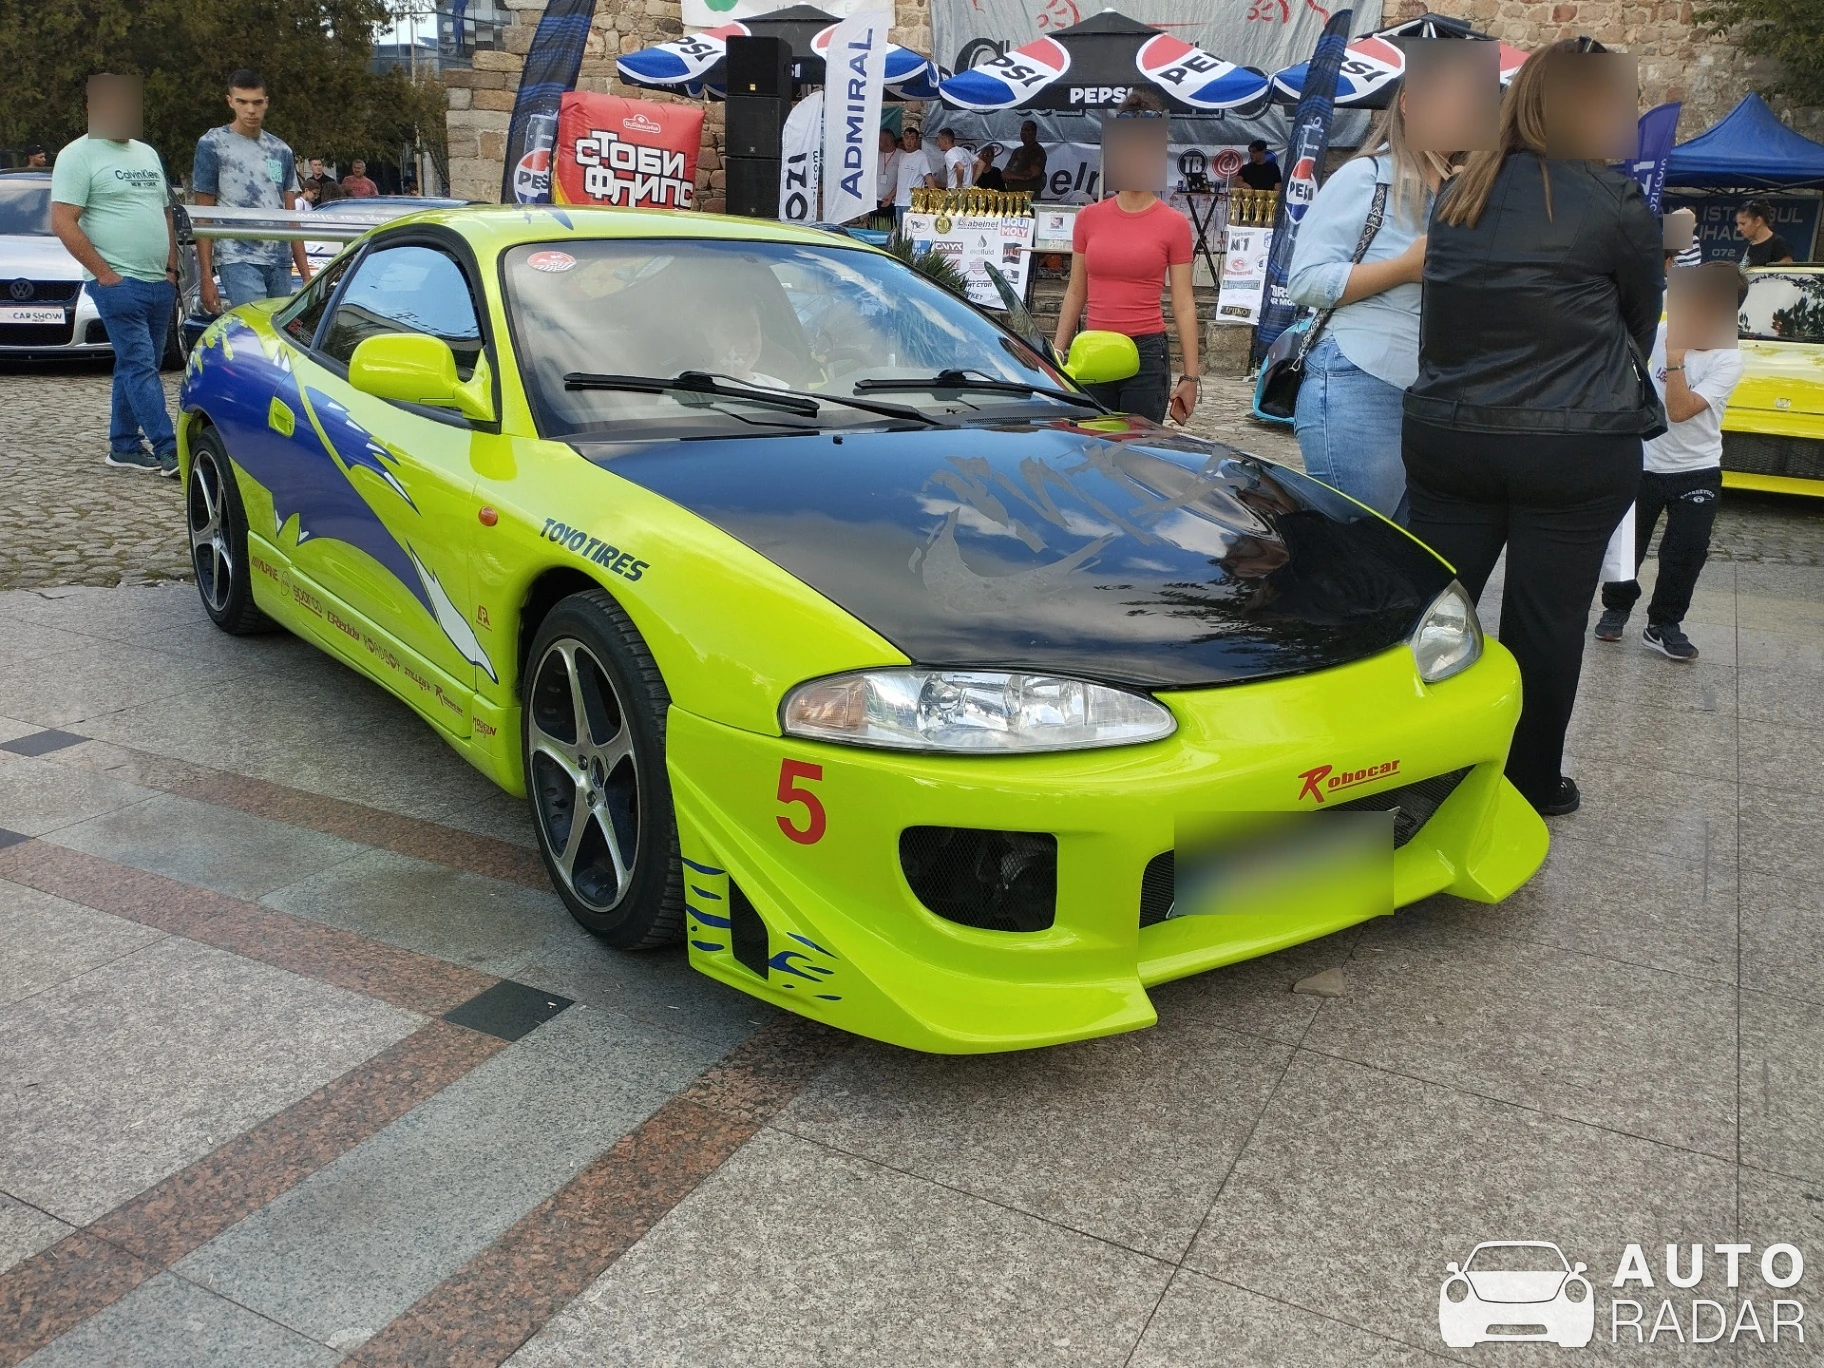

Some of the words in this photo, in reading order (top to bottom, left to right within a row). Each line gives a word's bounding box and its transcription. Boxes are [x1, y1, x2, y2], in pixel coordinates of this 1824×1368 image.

[841, 28, 873, 200] ADMIRAL
[575, 129, 686, 179] СТОБИ
[585, 165, 695, 208] ФЛИПС
[785, 152, 808, 220] OZI
[1001, 228, 1028, 238] MOLY
[1703, 205, 1803, 224] ISTBUL
[13, 312, 31, 320] CAR
[32, 312, 63, 320] SHOW
[540, 517, 587, 552] TOYO
[581, 537, 651, 582] TIRES
[775, 758, 827, 846] 5
[1298, 759, 1400, 804] Robocar
